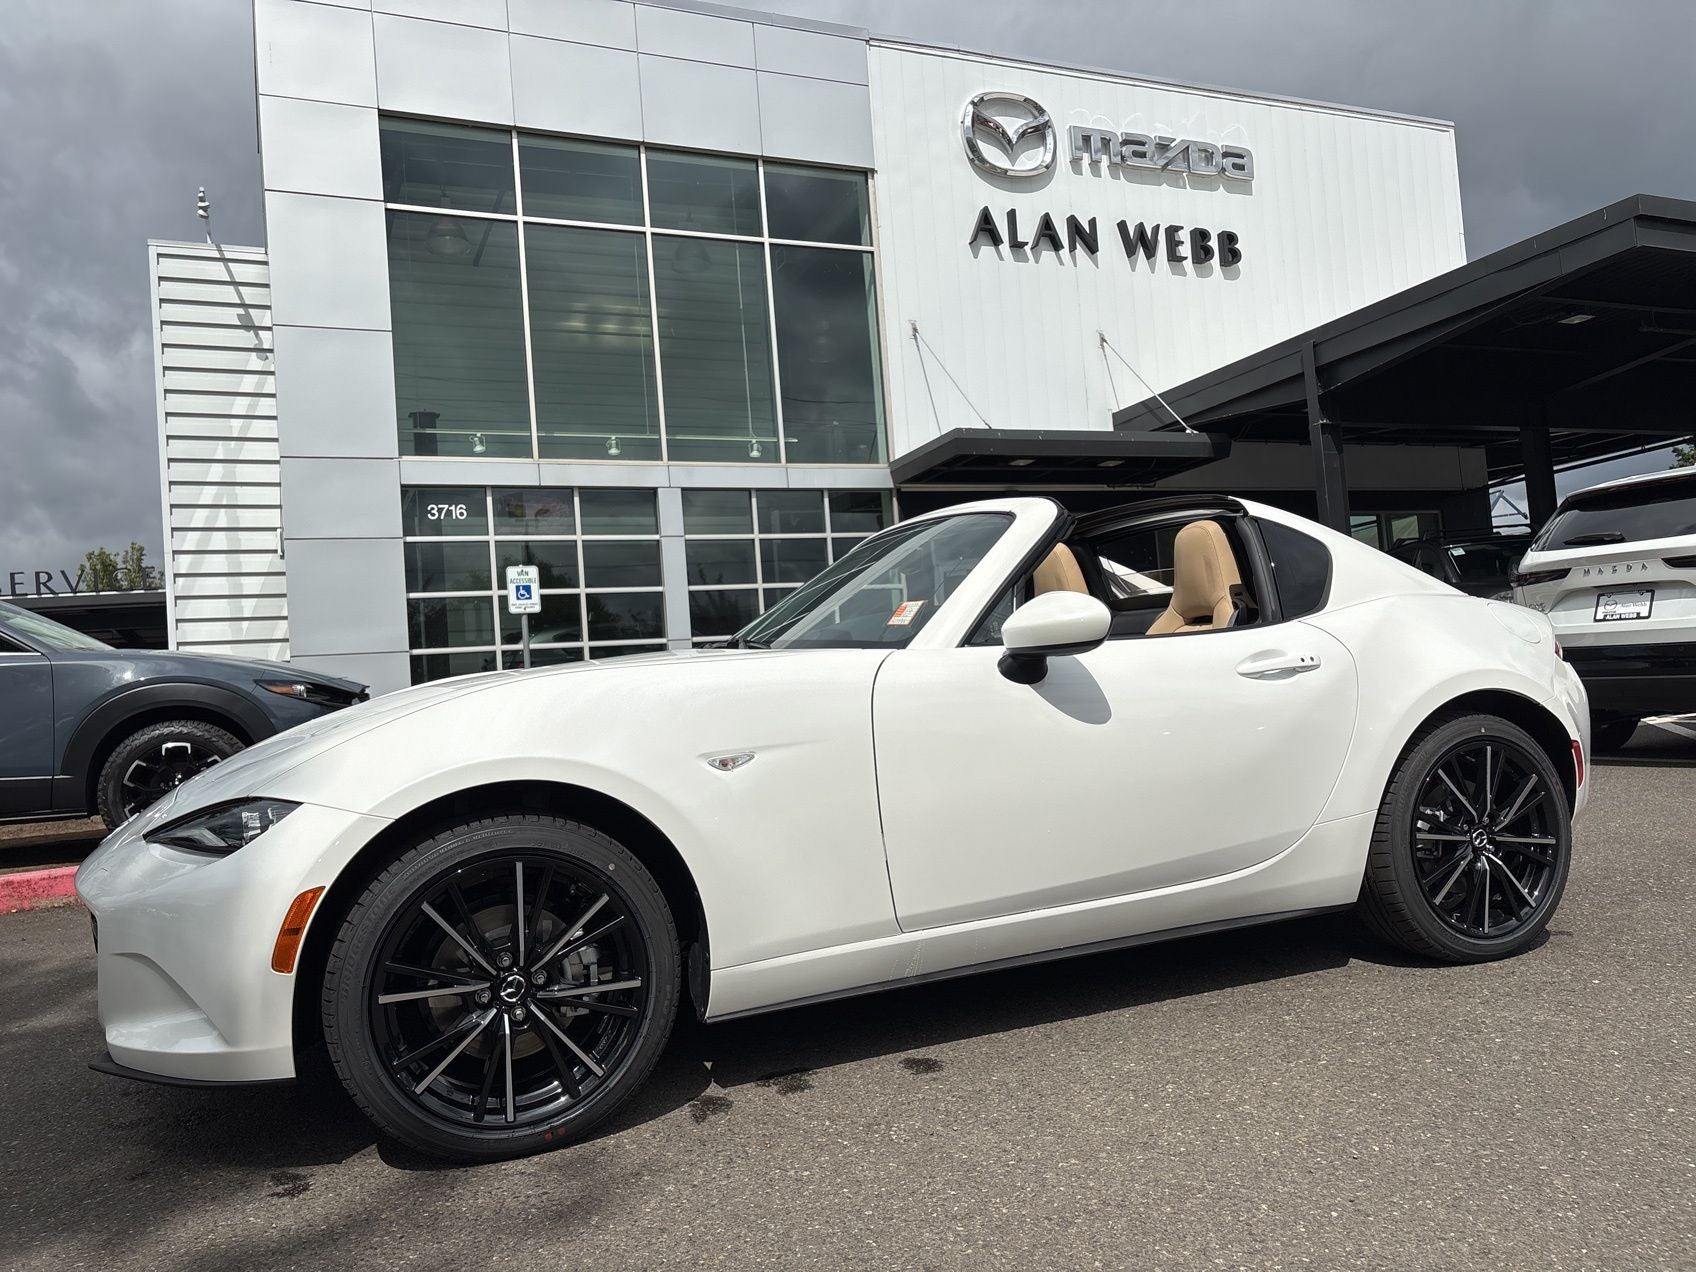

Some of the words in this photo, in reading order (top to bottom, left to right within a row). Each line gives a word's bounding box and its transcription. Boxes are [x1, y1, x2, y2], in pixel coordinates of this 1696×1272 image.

[969, 205, 1100, 256] ALAN
[1116, 219, 1242, 267] WEBB
[427, 504, 467, 520] 3716
[1583, 562, 1648, 577] MAZDA
[0, 566, 156, 597] ERVICE
